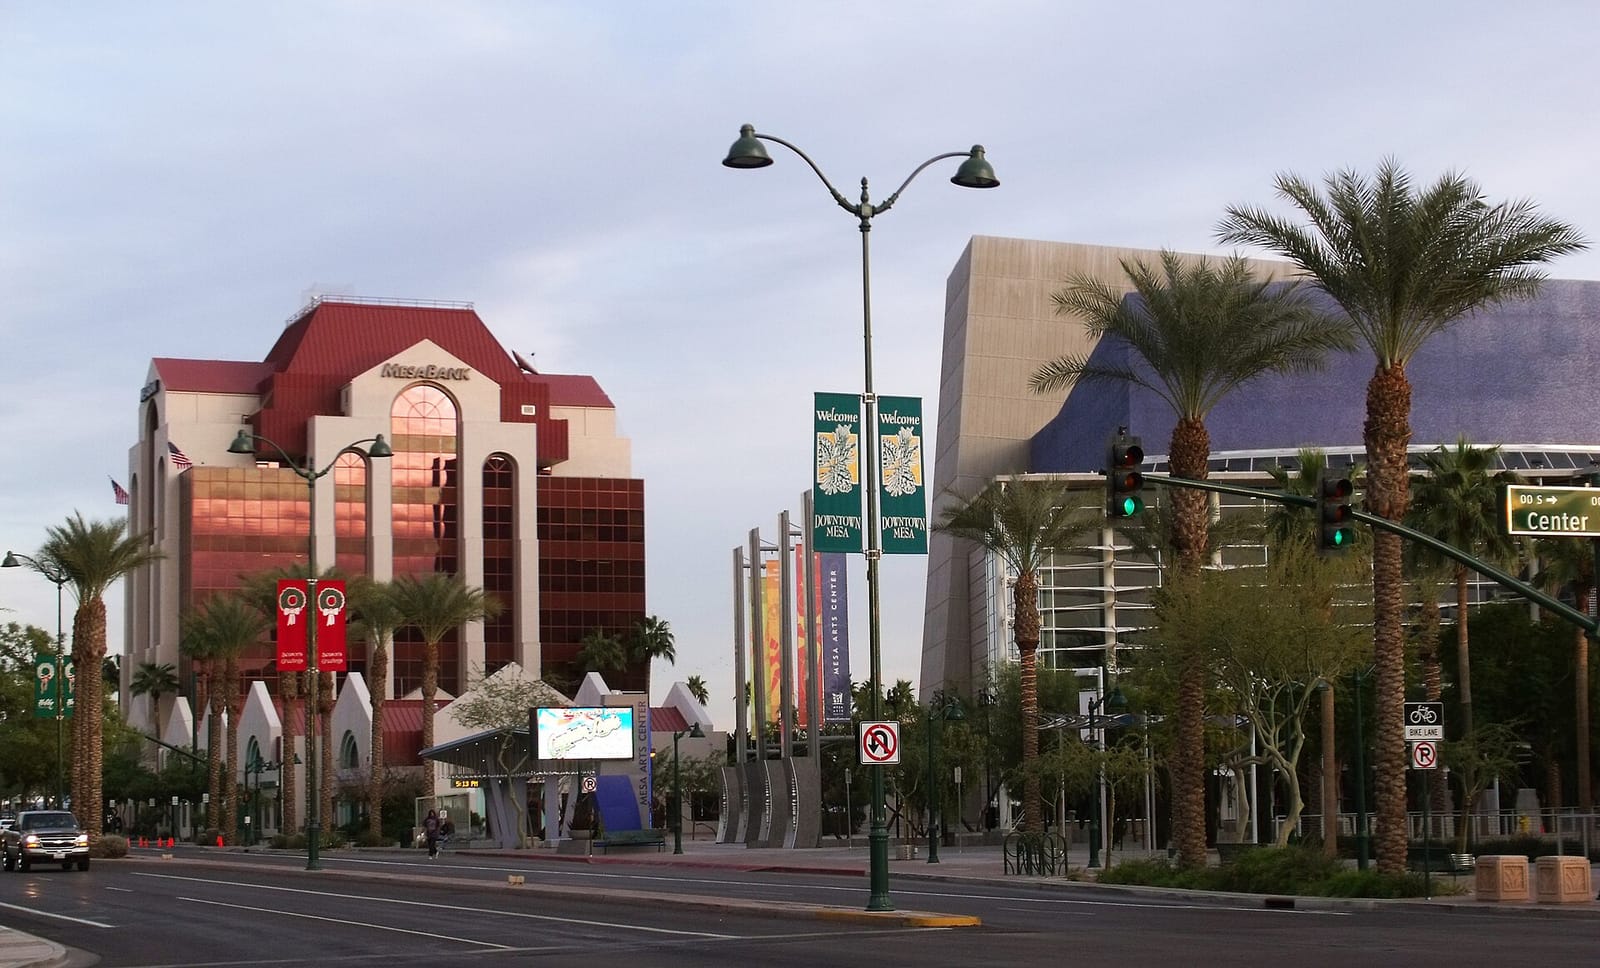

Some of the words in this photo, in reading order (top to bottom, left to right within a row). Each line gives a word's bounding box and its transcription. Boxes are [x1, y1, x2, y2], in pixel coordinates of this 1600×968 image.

[816, 407, 858, 423] Welcome
[880, 410, 920, 425] Welcome
[1520, 495, 1533, 504] 00
[1537, 495, 1543, 504] S
[815, 515, 861, 530] DOWNTOWN
[882, 516, 925, 530] DOWNTOWN
[1528, 512, 1588, 530] Center
[826, 526, 849, 537] MESA
[893, 528, 915, 538] MESA
[638, 701, 647, 741] CENTER
[639, 746, 647, 773] ARTS
[639, 776, 648, 806] MESA
